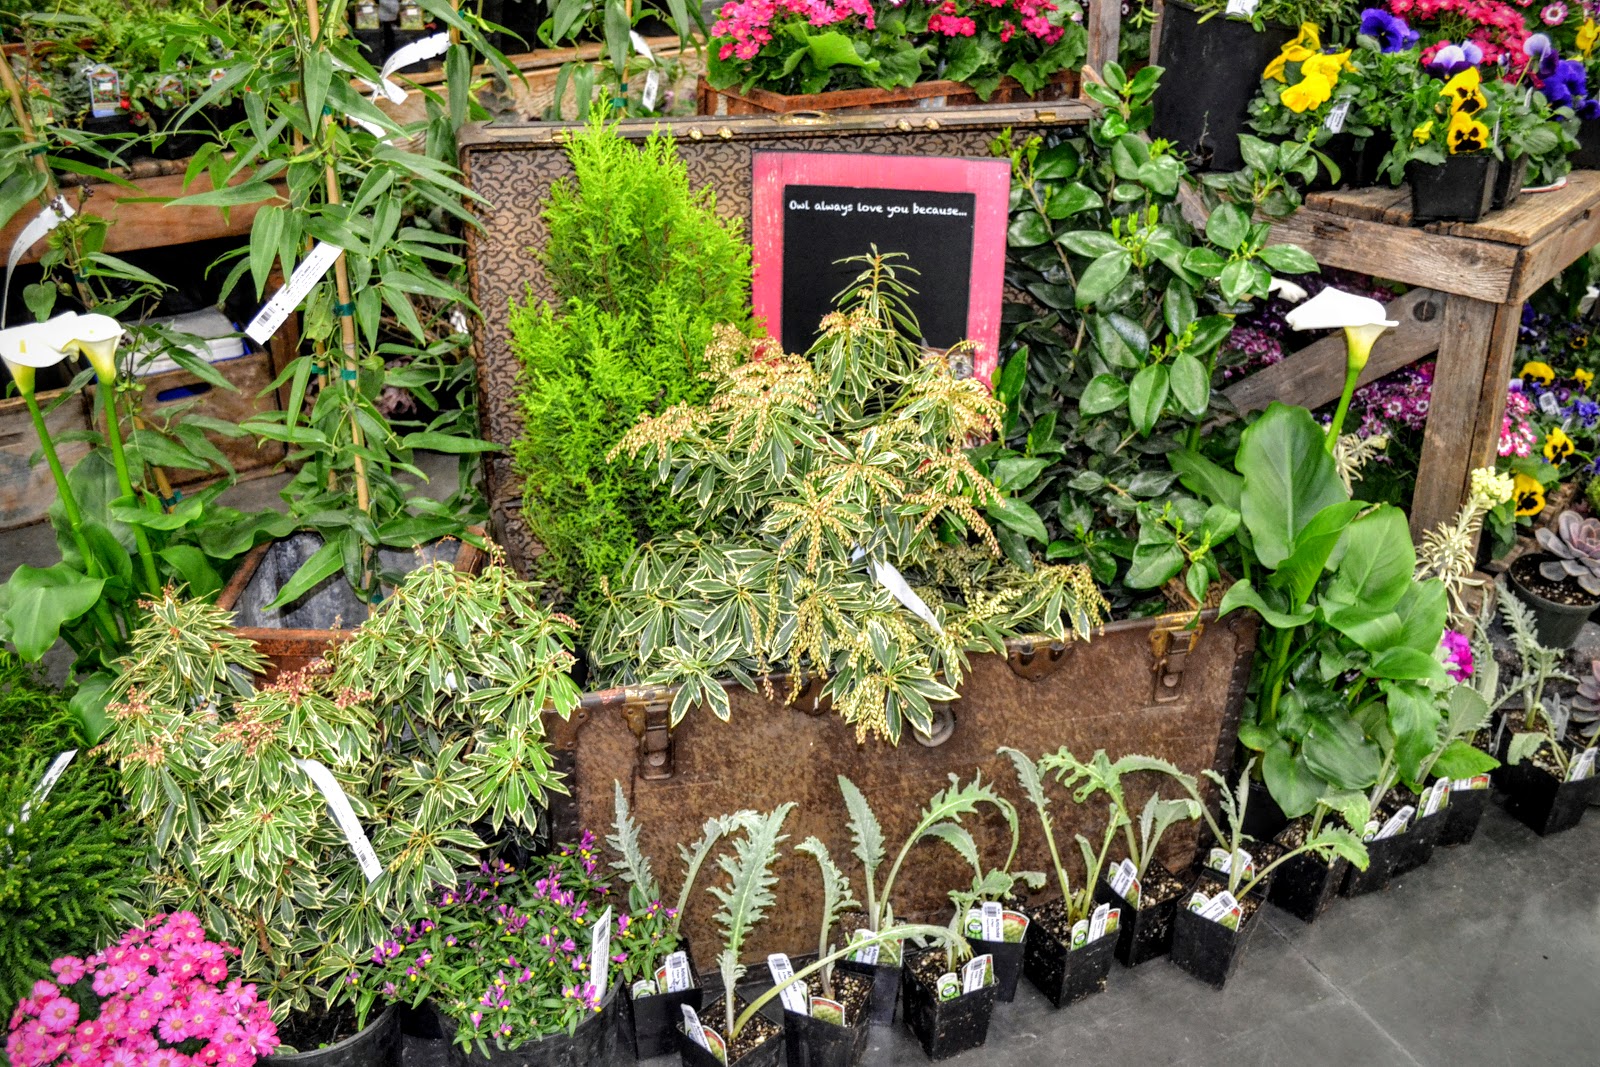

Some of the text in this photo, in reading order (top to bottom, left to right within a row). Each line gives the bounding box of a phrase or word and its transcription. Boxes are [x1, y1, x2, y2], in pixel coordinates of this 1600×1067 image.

[789, 200, 967, 218] Owl always love you because...
